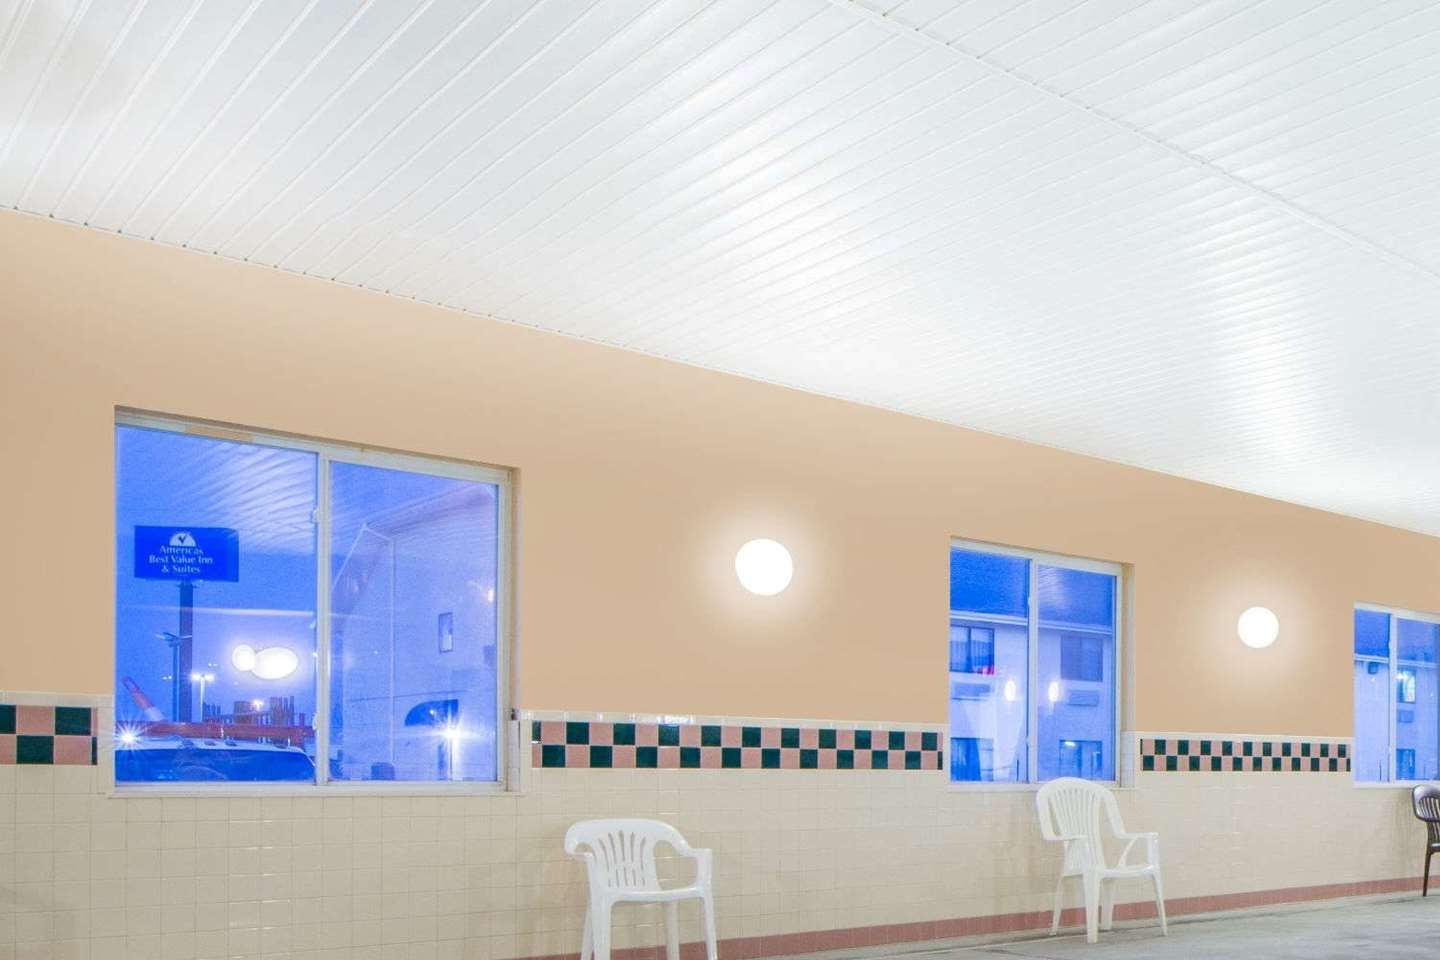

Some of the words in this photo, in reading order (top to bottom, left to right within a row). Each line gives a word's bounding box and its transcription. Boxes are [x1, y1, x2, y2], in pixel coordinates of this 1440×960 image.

[149, 555, 169, 564] Best
[170, 555, 196, 564] Value
[198, 555, 213, 565] Inn
[172, 565, 201, 573] Suites
